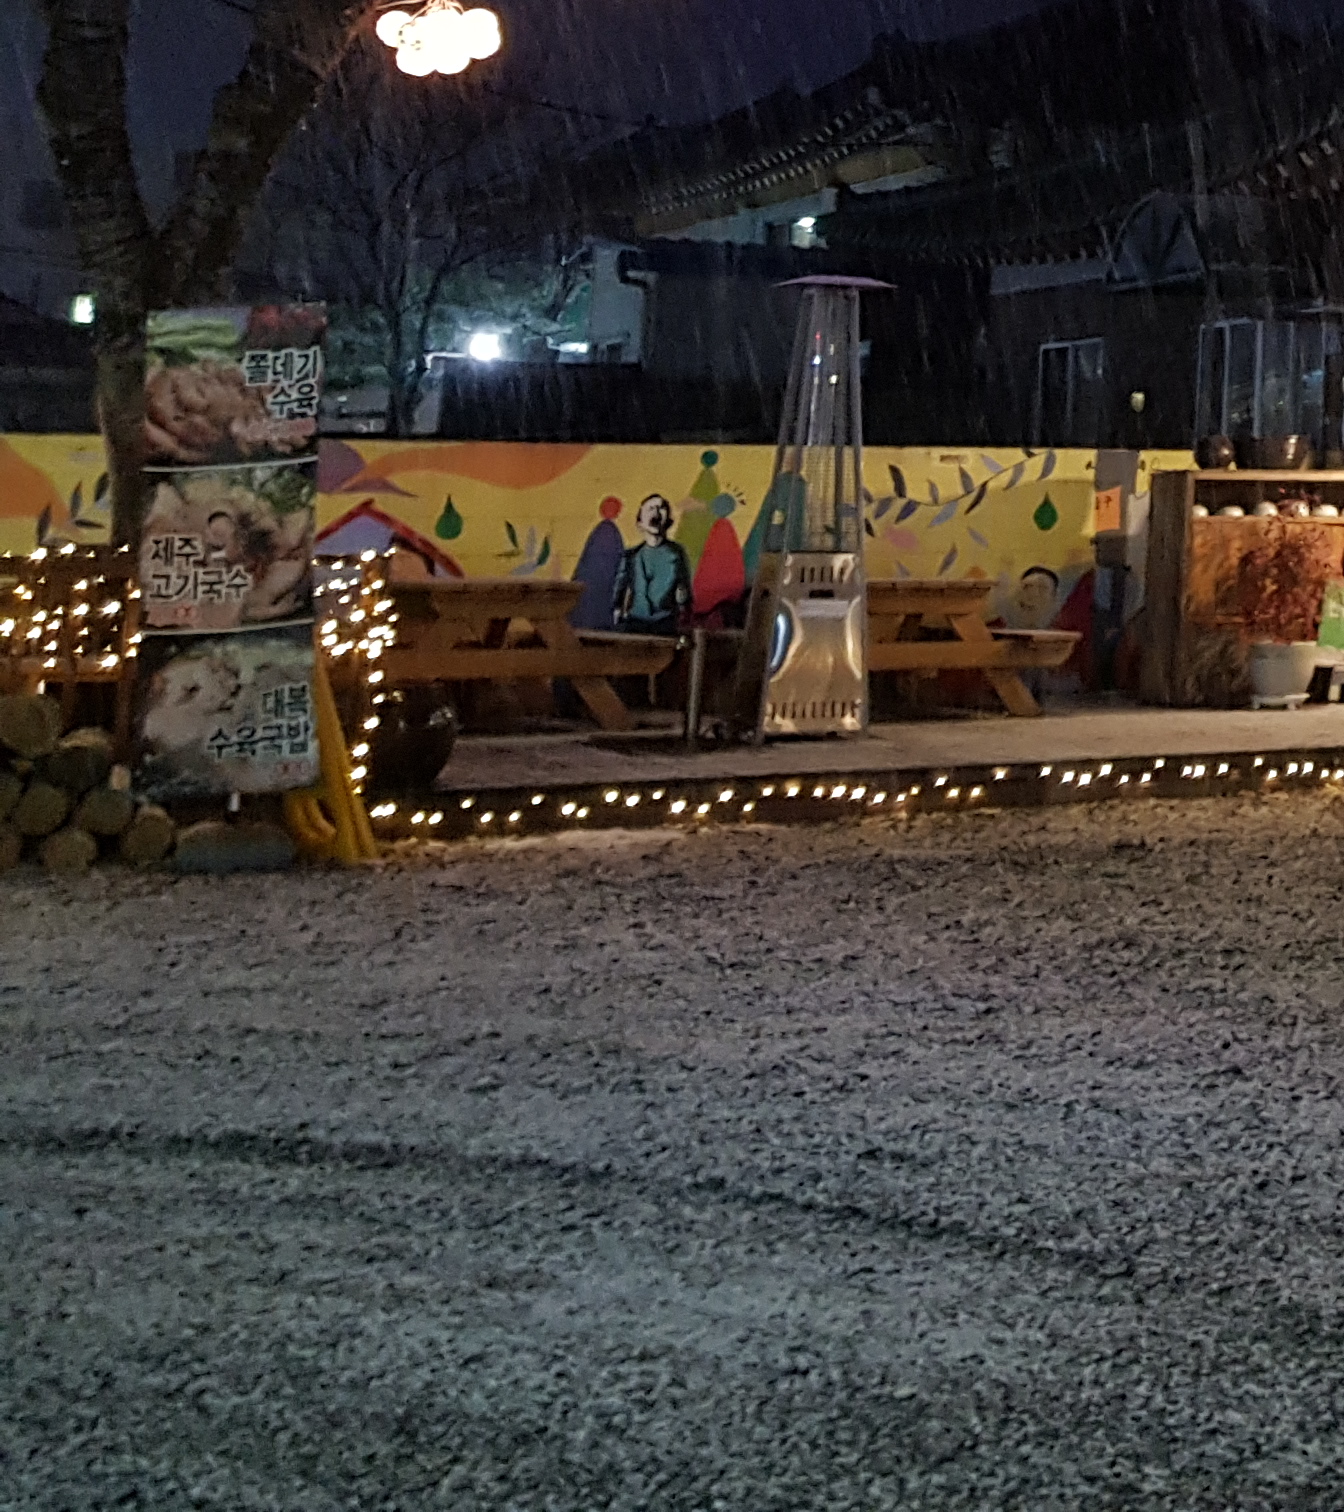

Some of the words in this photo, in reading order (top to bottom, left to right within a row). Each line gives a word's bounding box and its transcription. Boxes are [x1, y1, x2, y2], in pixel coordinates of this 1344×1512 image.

[267, 381, 318, 418] 수육
[150, 535, 202, 568] 제주
[148, 567, 252, 603] 고기국수
[260, 682, 311, 717] 대복
[207, 716, 313, 760] 수육국밥
